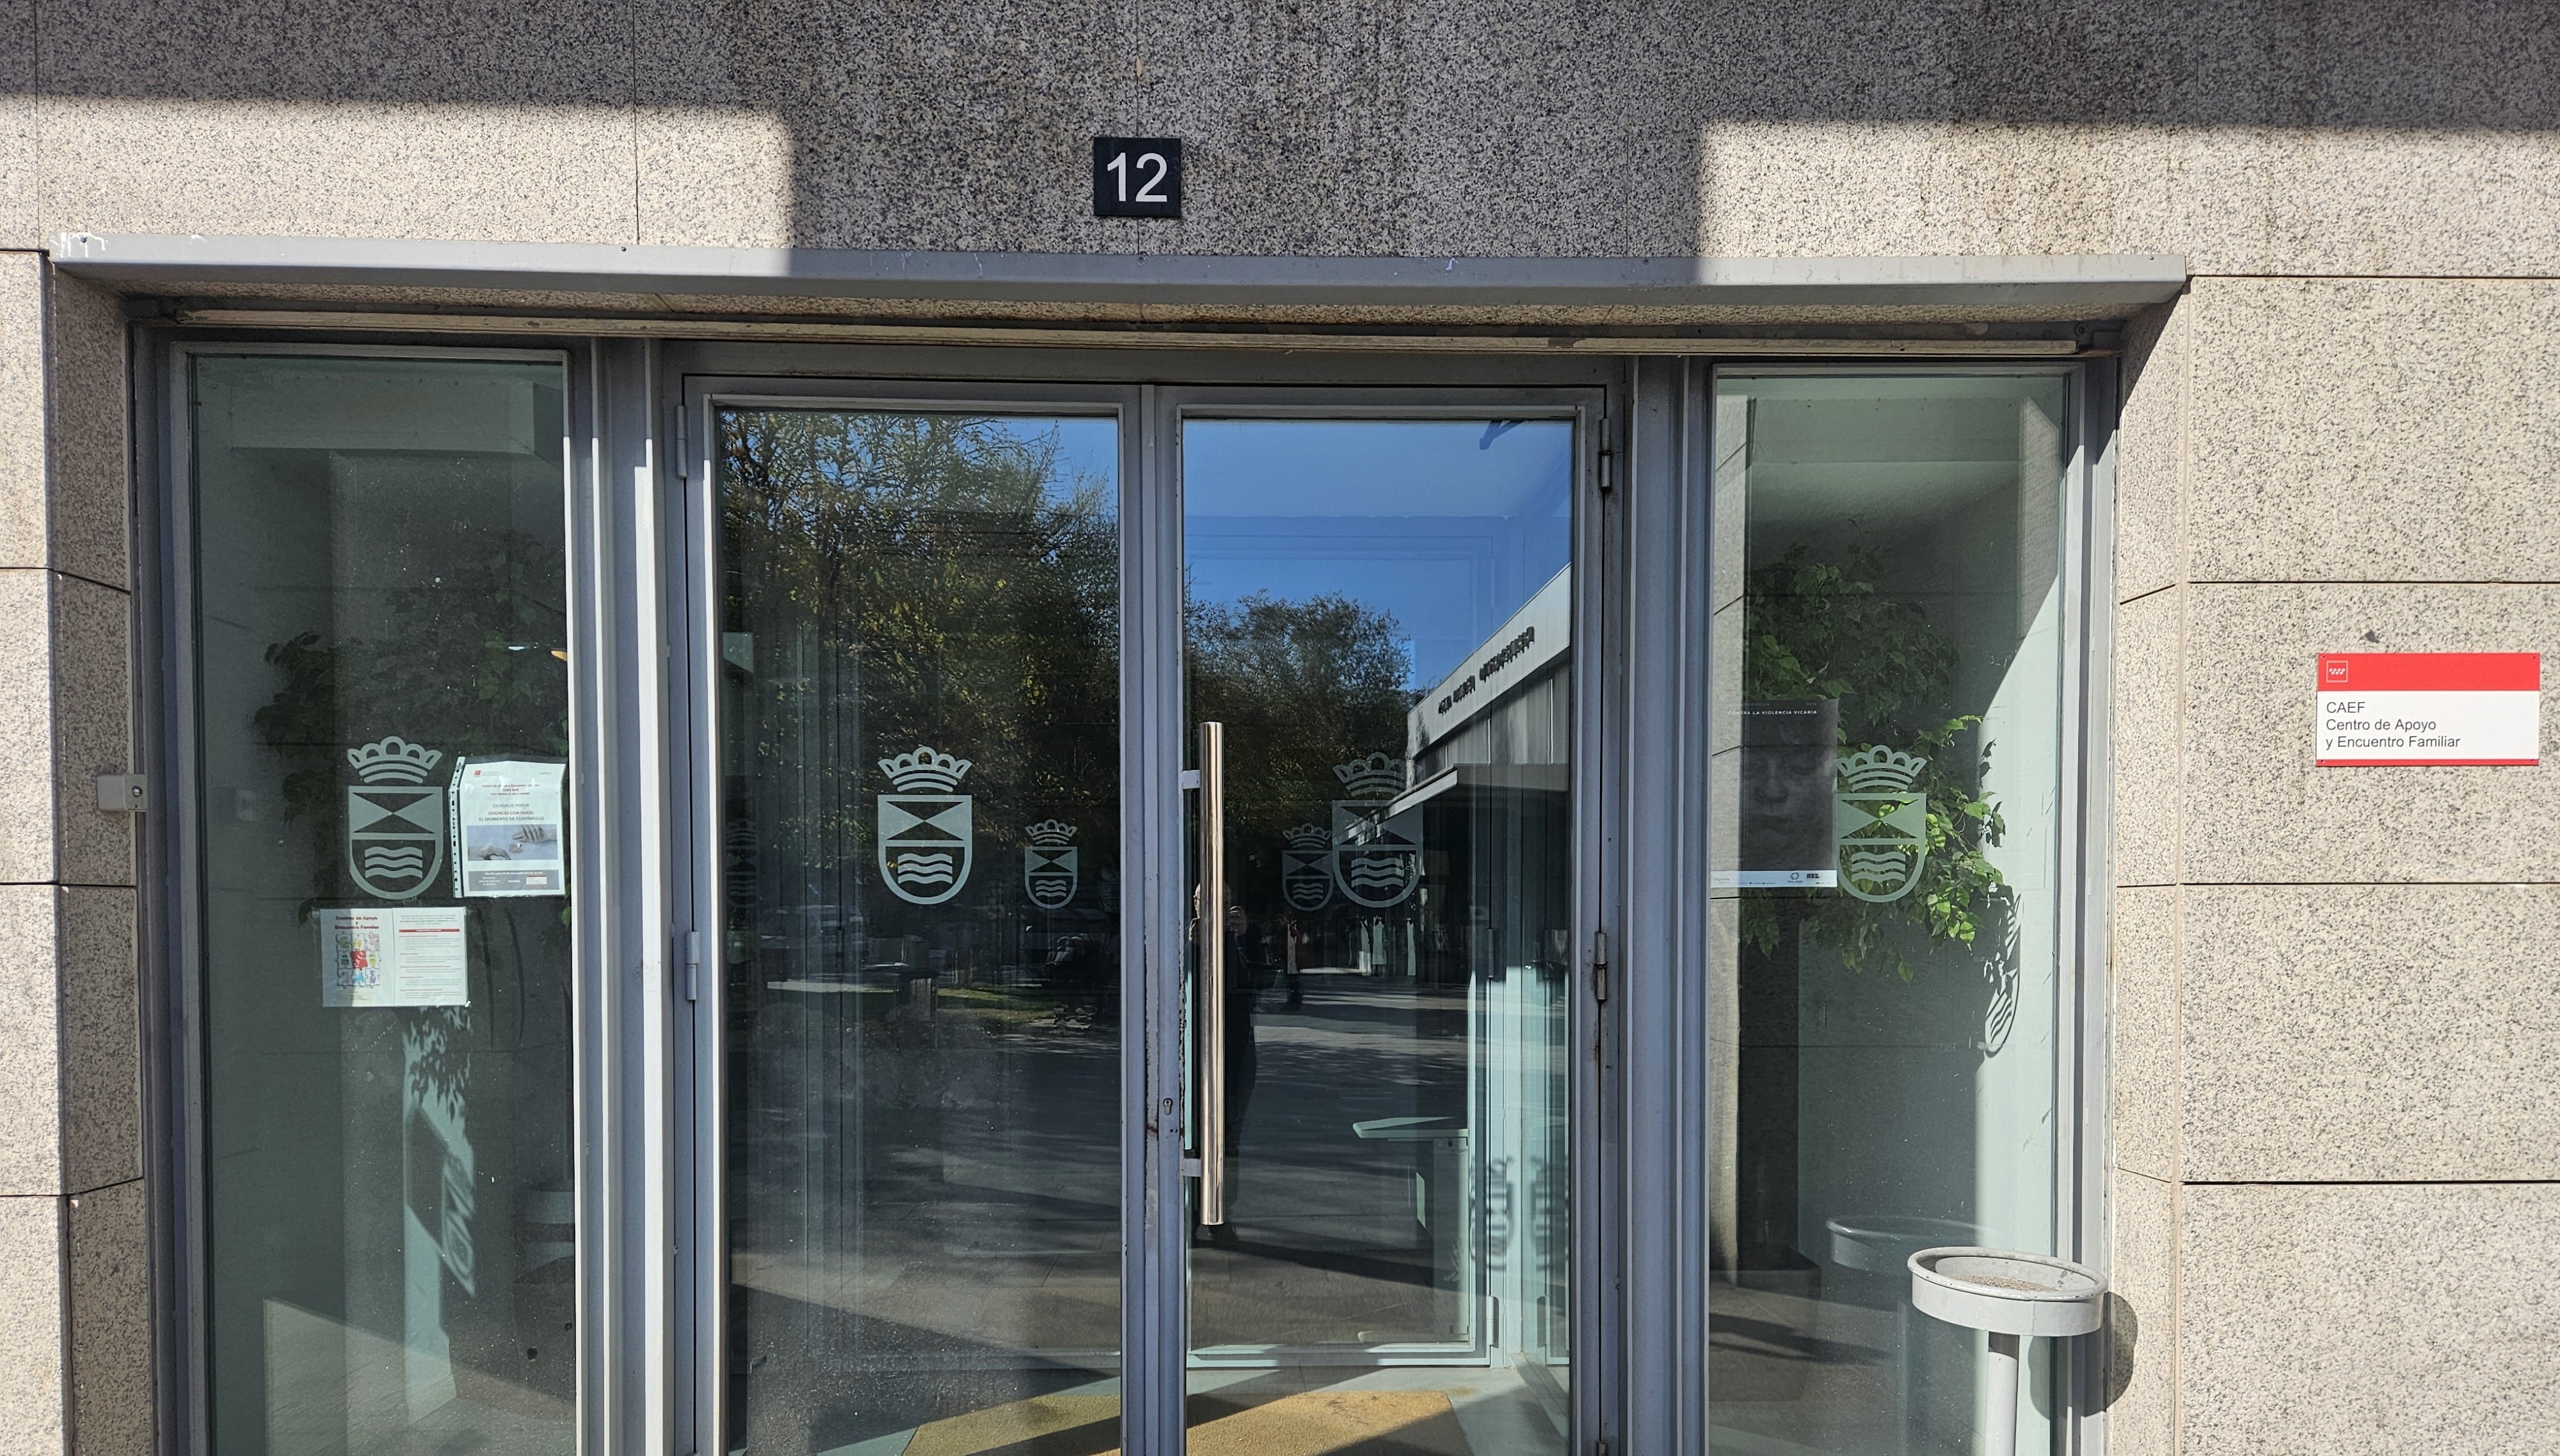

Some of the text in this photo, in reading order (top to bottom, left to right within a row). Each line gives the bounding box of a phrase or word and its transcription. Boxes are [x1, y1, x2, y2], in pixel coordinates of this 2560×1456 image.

[1107, 152, 1167, 202] 12
[2326, 701, 2365, 714] CAEF
[2326, 719, 2436, 733] Centro de Apoyo
[2326, 736, 2461, 751] y Encuentro Familiar
